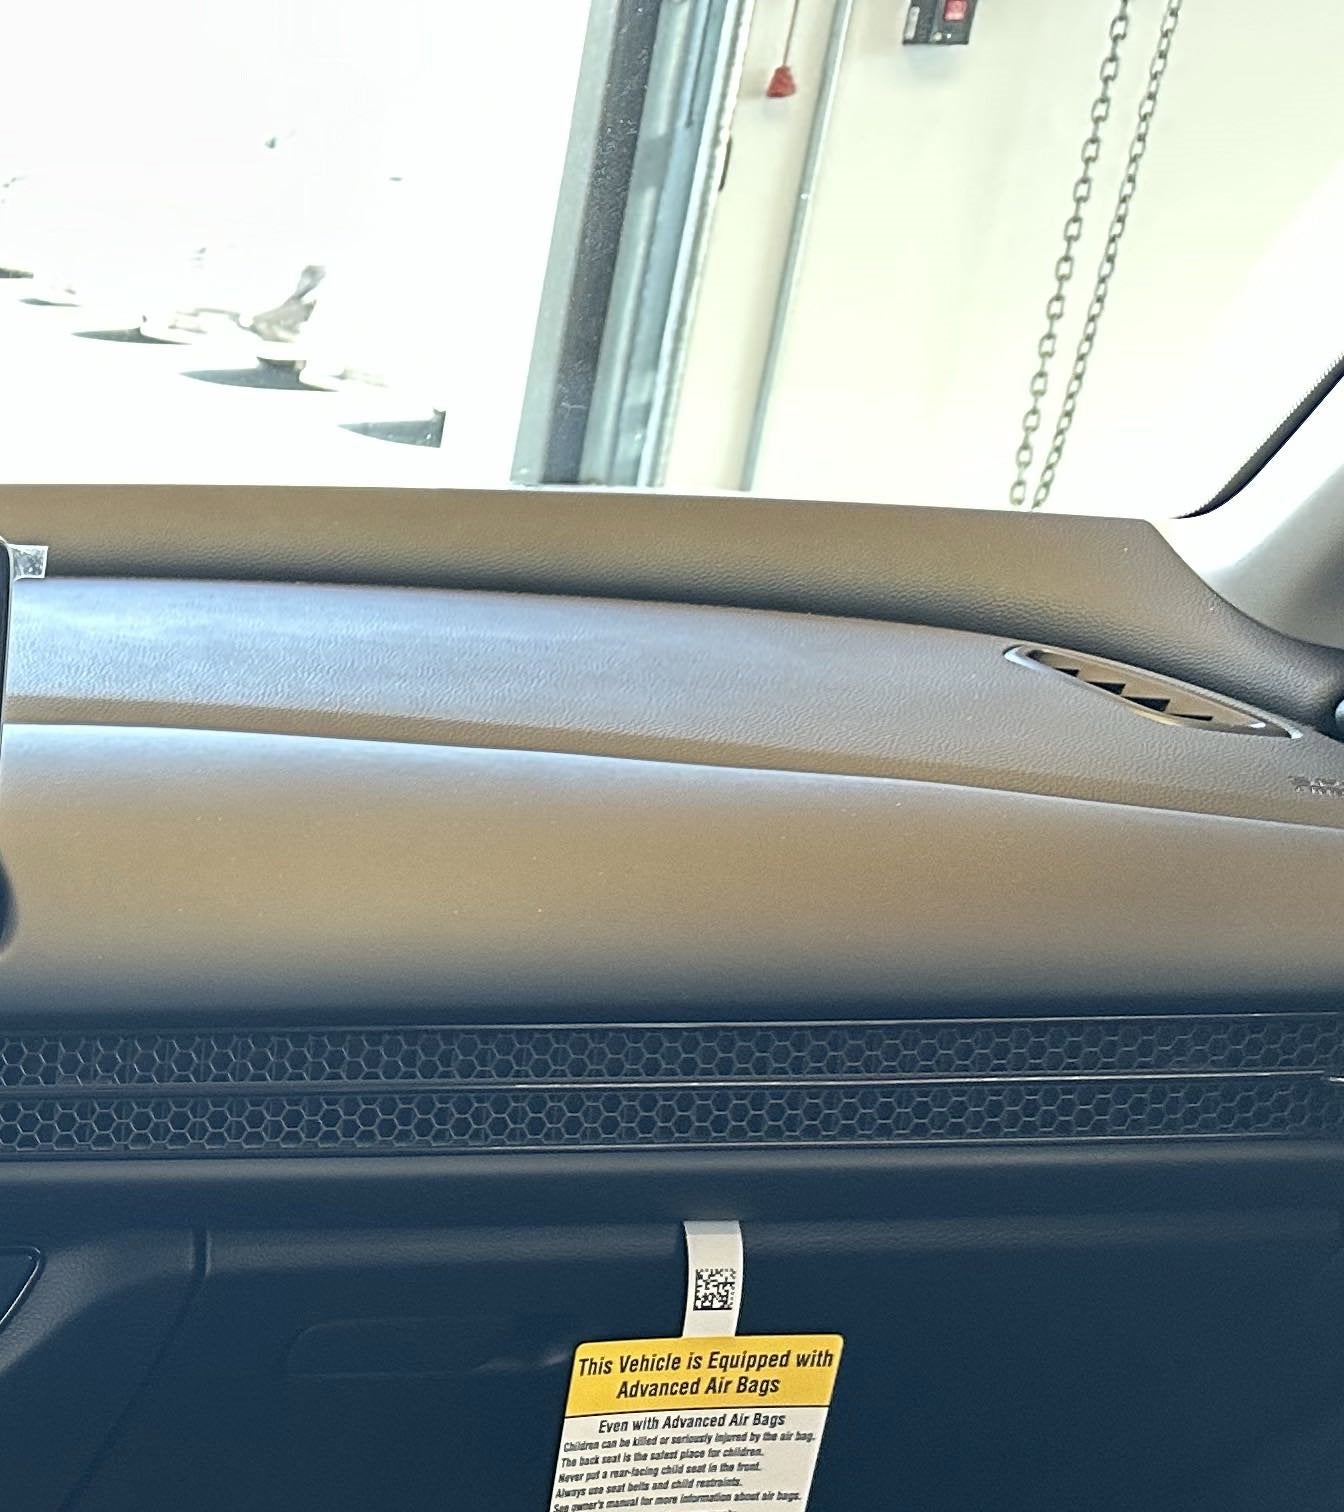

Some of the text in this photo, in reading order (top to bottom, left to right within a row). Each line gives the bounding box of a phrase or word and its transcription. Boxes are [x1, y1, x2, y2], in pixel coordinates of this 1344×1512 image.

[578, 1349, 834, 1376] This Vehicle is Equipped with
[616, 1375, 780, 1399] Advanced Air Bags
[598, 1412, 787, 1434] Even with Advanced Air Bags
[564, 1441, 599, 1452] Children
[602, 1440, 617, 1449] can
[619, 1438, 630, 1447] be
[632, 1435, 658, 1446] killed
[660, 1437, 669, 1445] or
[671, 1433, 712, 1444] seriously
[714, 1432, 748, 1444] injured
[750, 1432, 761, 1442] by
[763, 1432, 778, 1441] the
[780, 1431, 793, 1441] air
[561, 1458, 576, 1468] The
[579, 1455, 599, 1466] back
[602, 1453, 621, 1464] seat
[623, 1452, 632, 1462] is
[634, 1452, 648, 1461] the
[651, 1450, 678, 1460] safest
[680, 1449, 705, 1460] place
[707, 1448, 721, 1458] for
[558, 1473, 584, 1483] Never
[586, 1471, 601, 1482] put
[602, 1470, 608, 1479] a
[610, 1466, 659, 1478] rear-facing
[661, 1464, 684, 1475] child
[686, 1463, 706, 1474] seat
[708, 1463, 717, 1472] in
[719, 1462, 734, 1472] the
[555, 1488, 586, 1498] Always
[588, 1487, 604, 1495] use
[606, 1484, 625, 1494] seat
[628, 1483, 649, 1492] belts
[652, 1480, 669, 1490] and
[671, 1479, 694, 1489] child
[606, 1497, 638, 1508] manual
[640, 1496, 653, 1505] for
[655, 1496, 678, 1505] more
[734, 1491, 760, 1501] about
[762, 1490, 775, 1501] air
